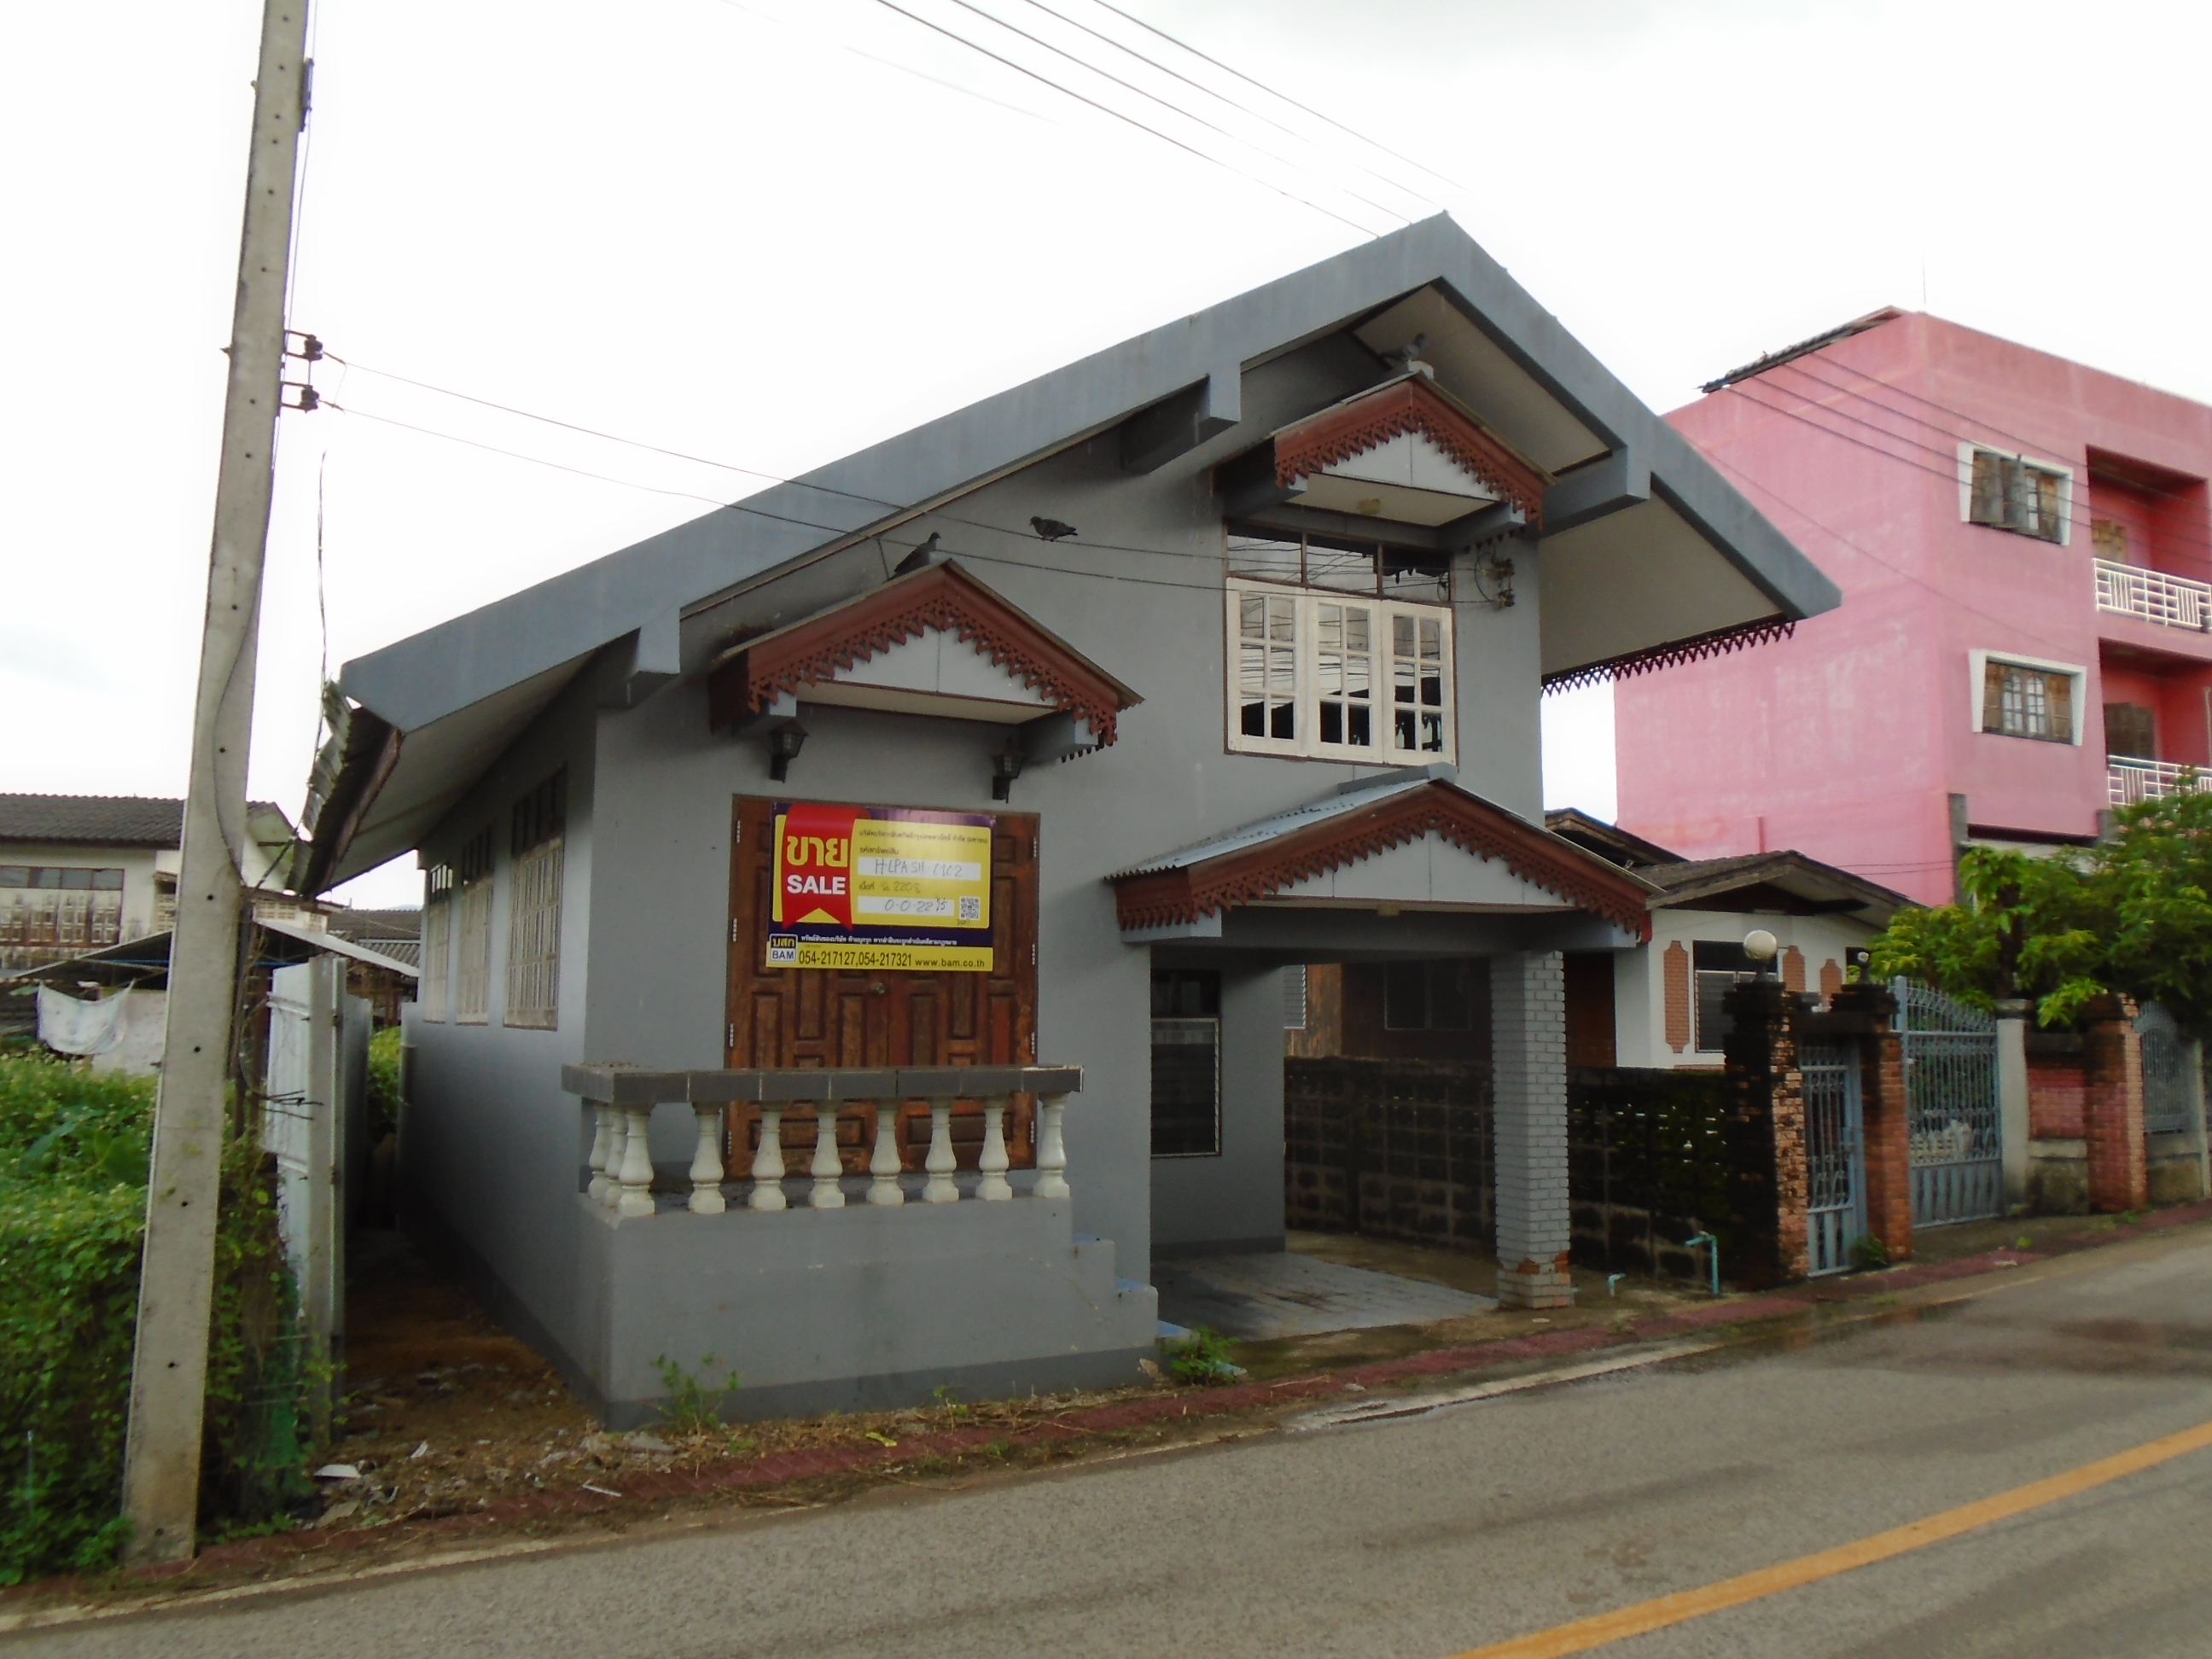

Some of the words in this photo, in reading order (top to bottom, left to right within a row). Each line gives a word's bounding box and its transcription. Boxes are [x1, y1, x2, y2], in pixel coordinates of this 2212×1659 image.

[787, 835, 848, 867] ขาย
[787, 875, 846, 894] SALE
[772, 937, 795, 947] บสก
[771, 950, 795, 959] BAM
[915, 958, 985, 968] www.bam.co.th
